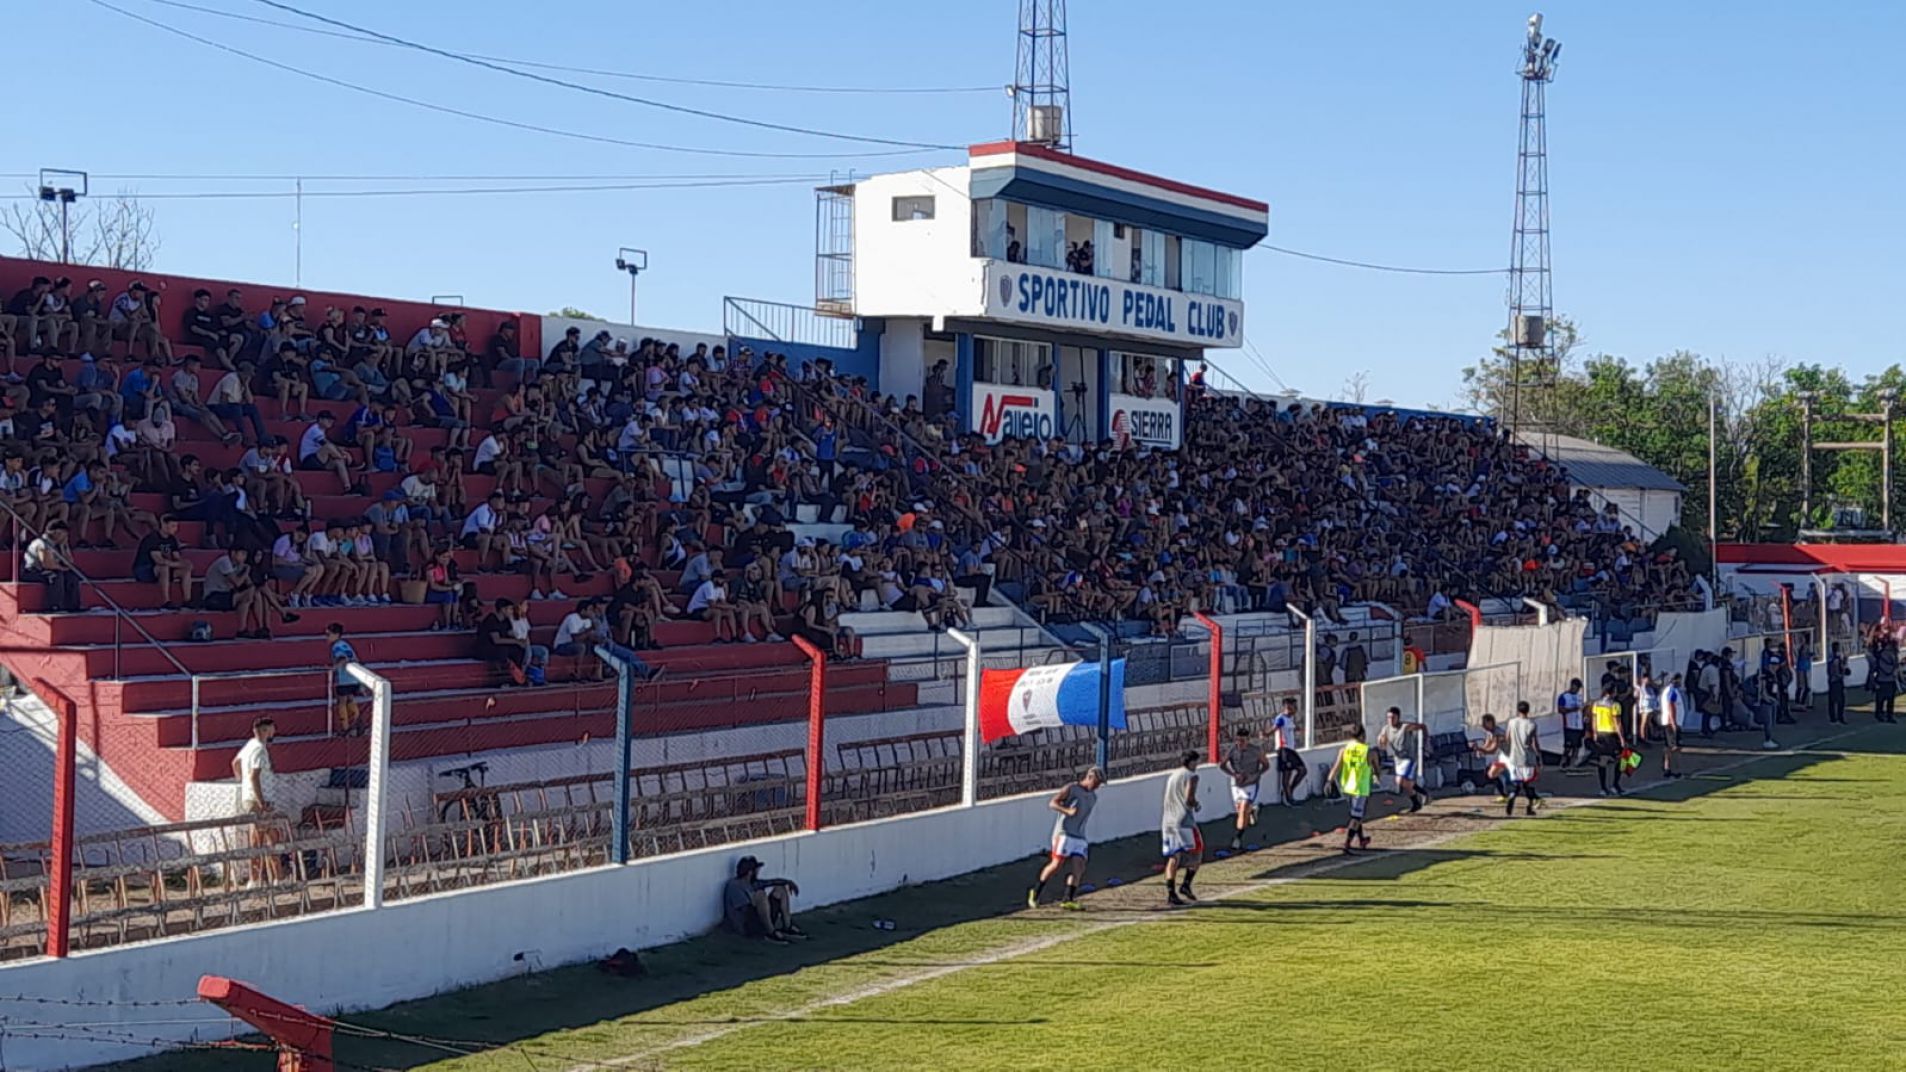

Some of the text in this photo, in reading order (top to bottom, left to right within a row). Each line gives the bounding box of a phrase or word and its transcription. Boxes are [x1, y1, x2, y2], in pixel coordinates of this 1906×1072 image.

[1018, 272, 1225, 339] SPORTIVO PEDAL CLUB
[1131, 410, 1172, 440] SIERRA
